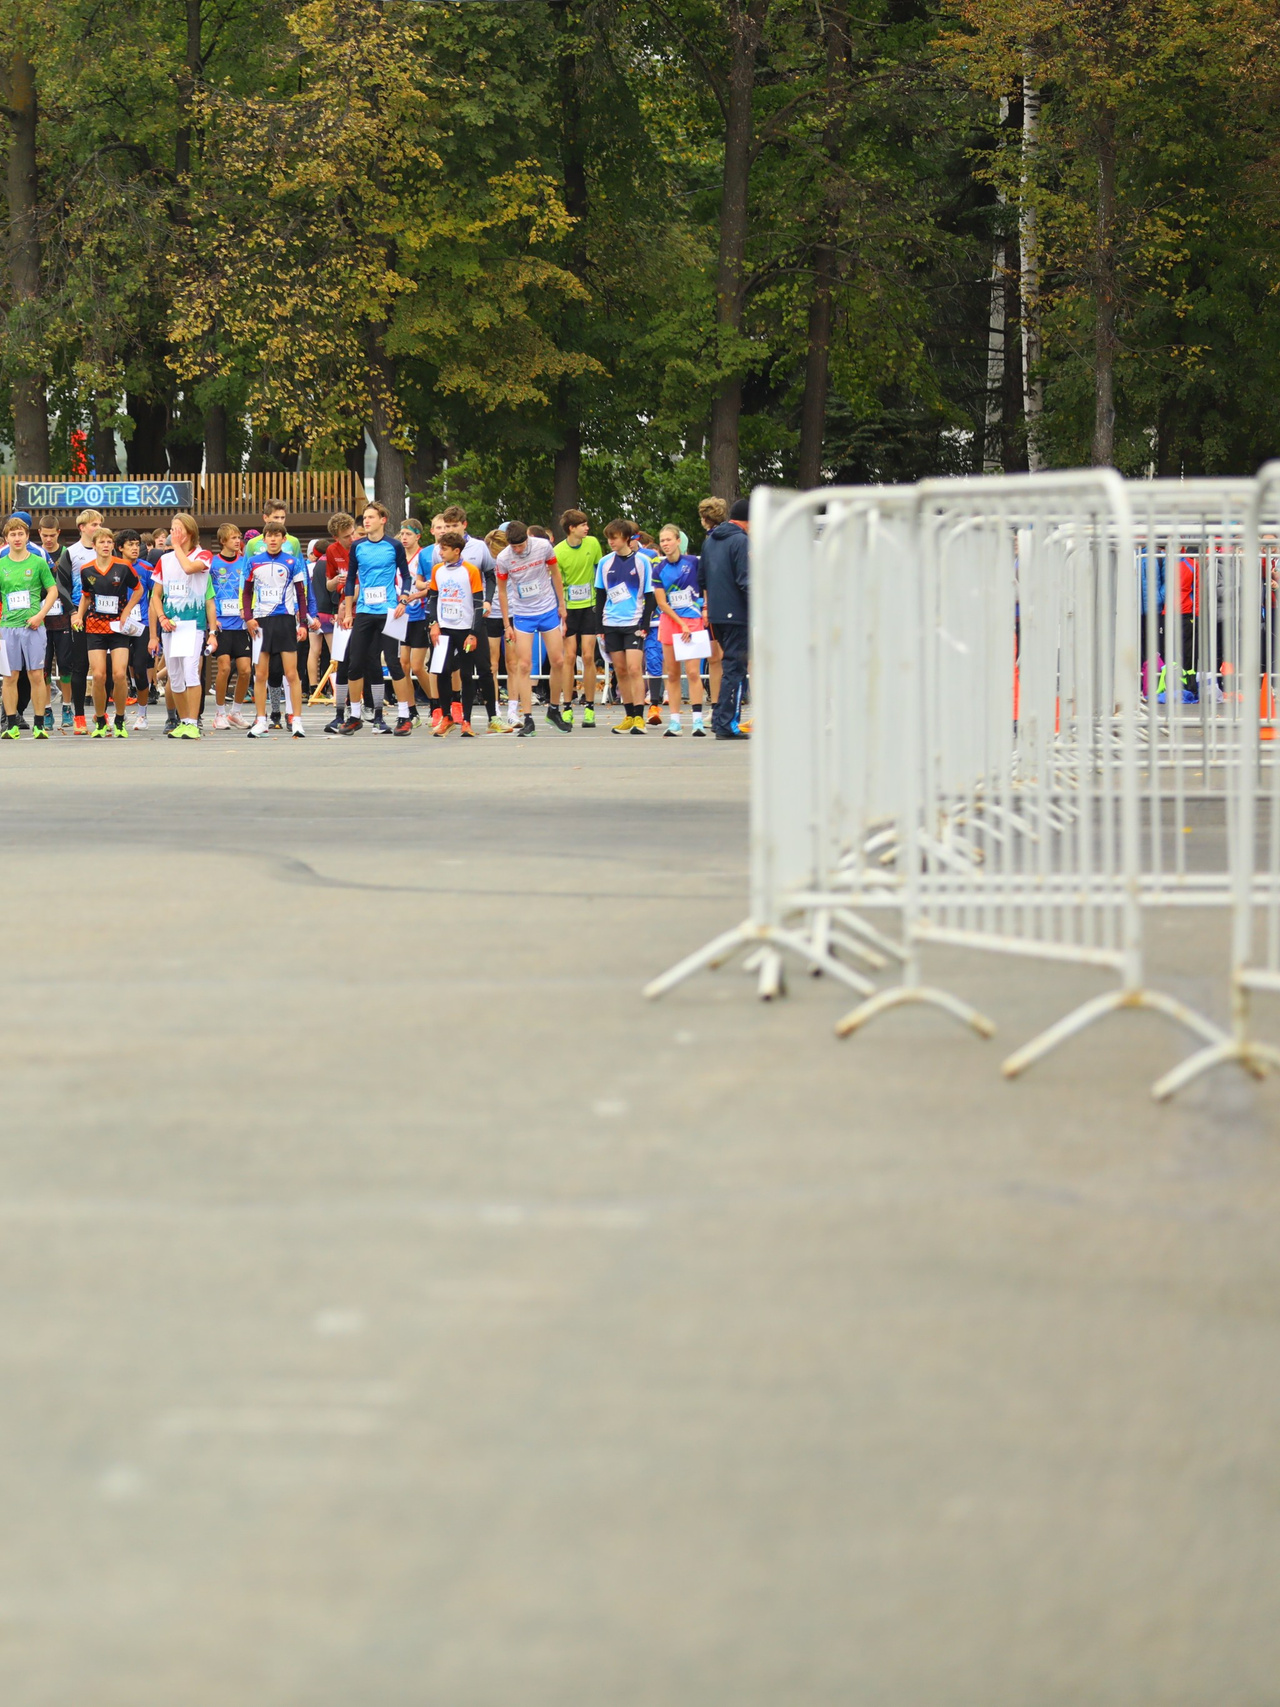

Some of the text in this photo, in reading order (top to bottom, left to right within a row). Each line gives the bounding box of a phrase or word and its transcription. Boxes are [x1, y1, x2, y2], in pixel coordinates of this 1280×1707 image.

[28, 484, 179, 506] ИГРОТЕКА
[261, 588, 278, 597] 315.1
[521, 584, 538, 594] 318.1
[10, 596, 26, 604] 312.1
[670, 594, 688, 602] 319.1
